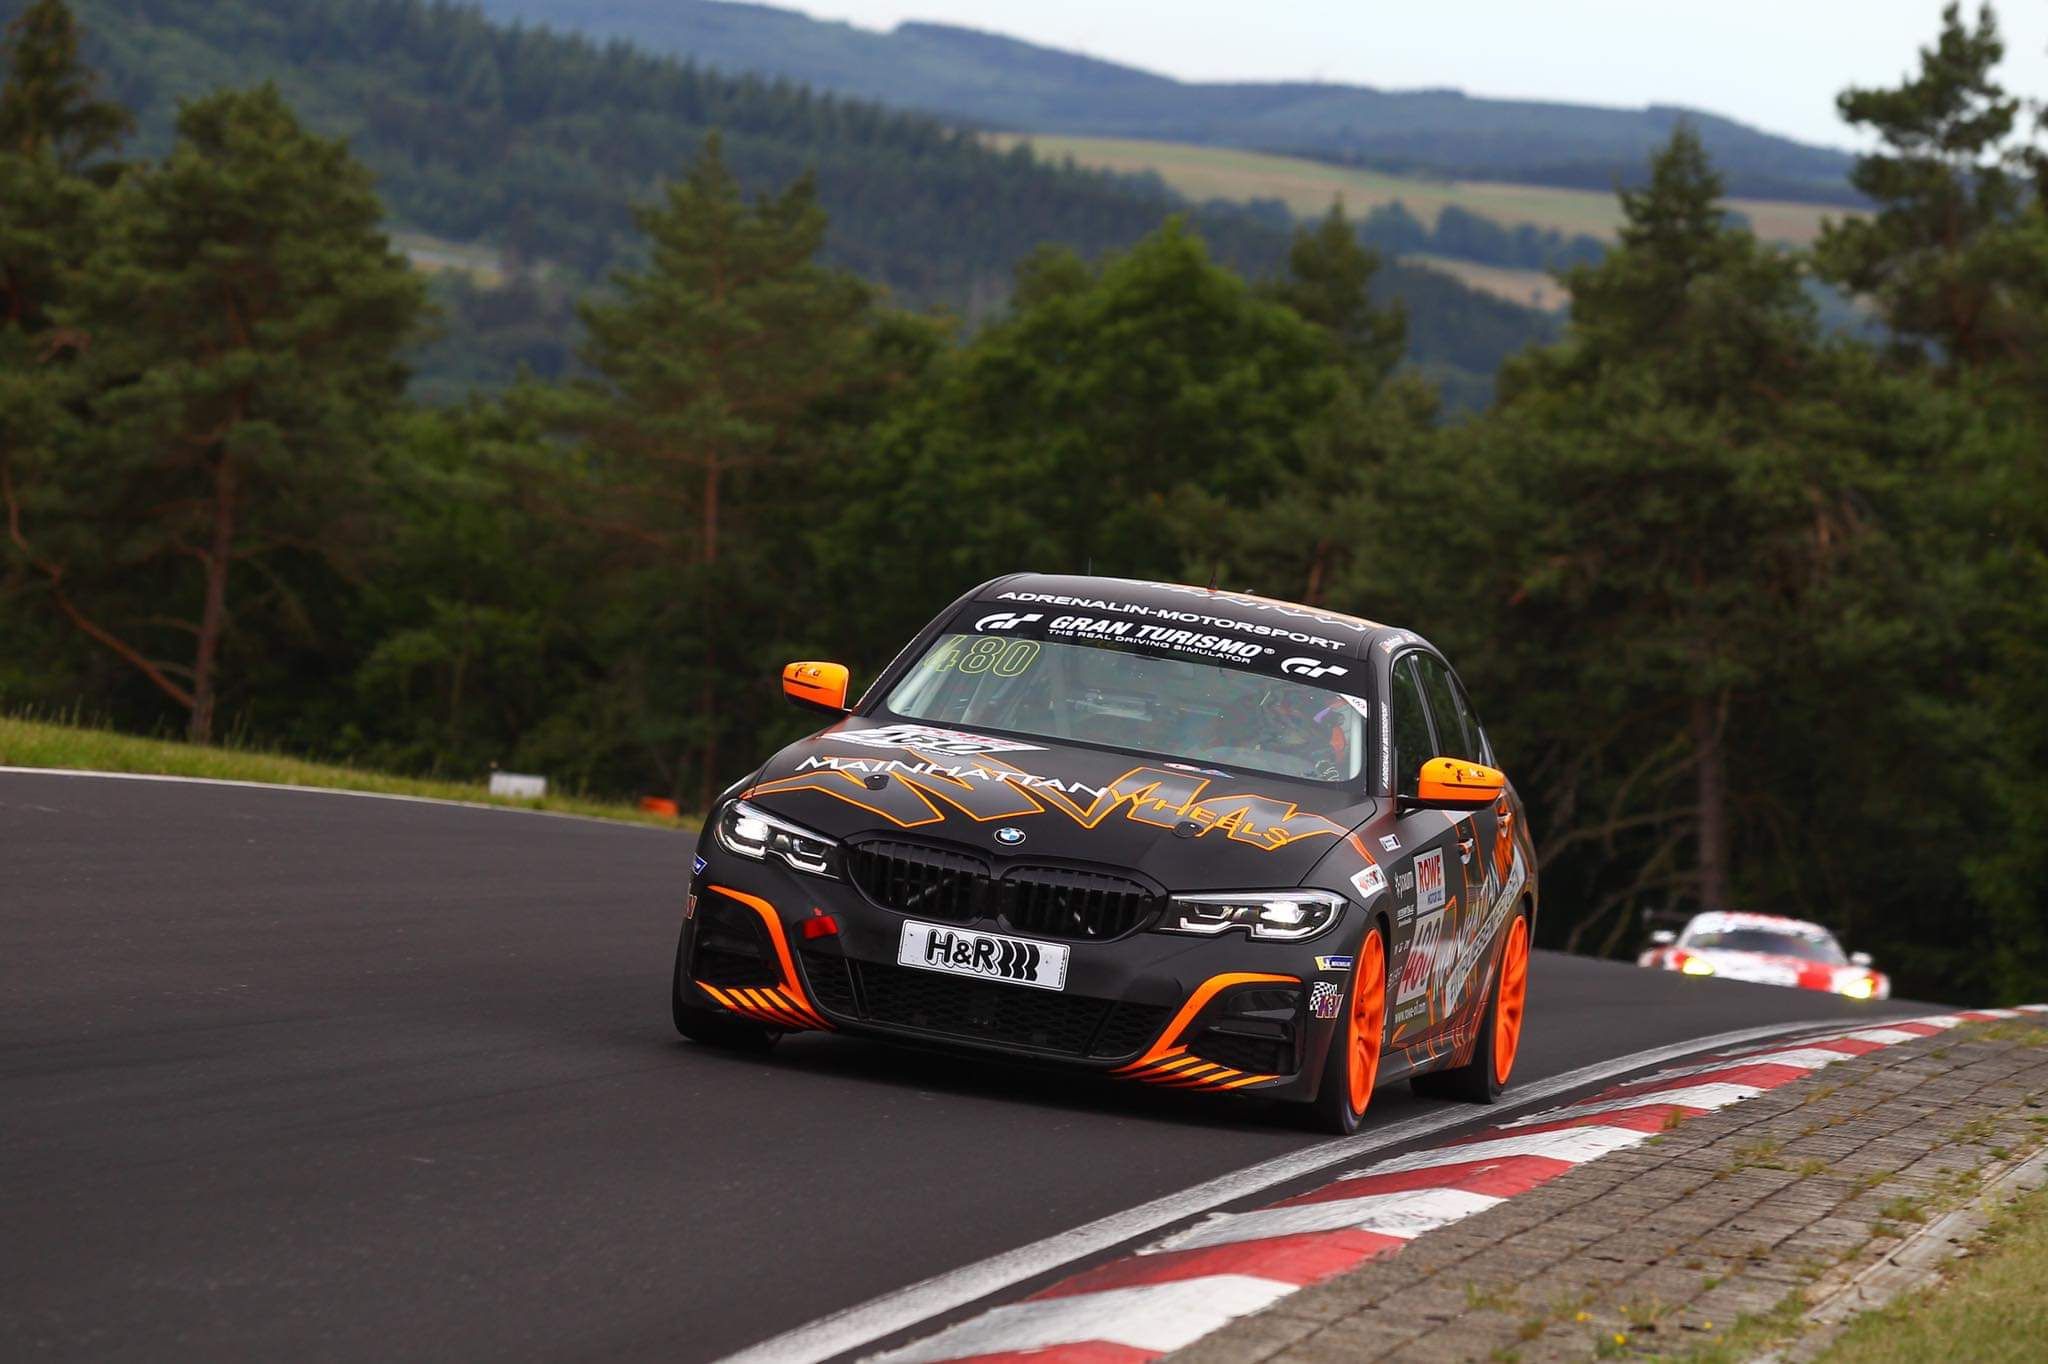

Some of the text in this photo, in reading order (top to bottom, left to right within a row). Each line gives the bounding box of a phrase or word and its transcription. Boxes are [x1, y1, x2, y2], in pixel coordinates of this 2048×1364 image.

[997, 592, 1346, 650] ADRENALIN-MOTORSPORT
[1049, 616, 1135, 635] GRAN
[923, 635, 1040, 676] 480
[1047, 629, 1251, 664] THE REAL DRIVING SIMULATOR
[796, 756, 1108, 798] MAINHATTAN
[1418, 855, 1441, 893] ROWE
[926, 930, 997, 973] H&R
